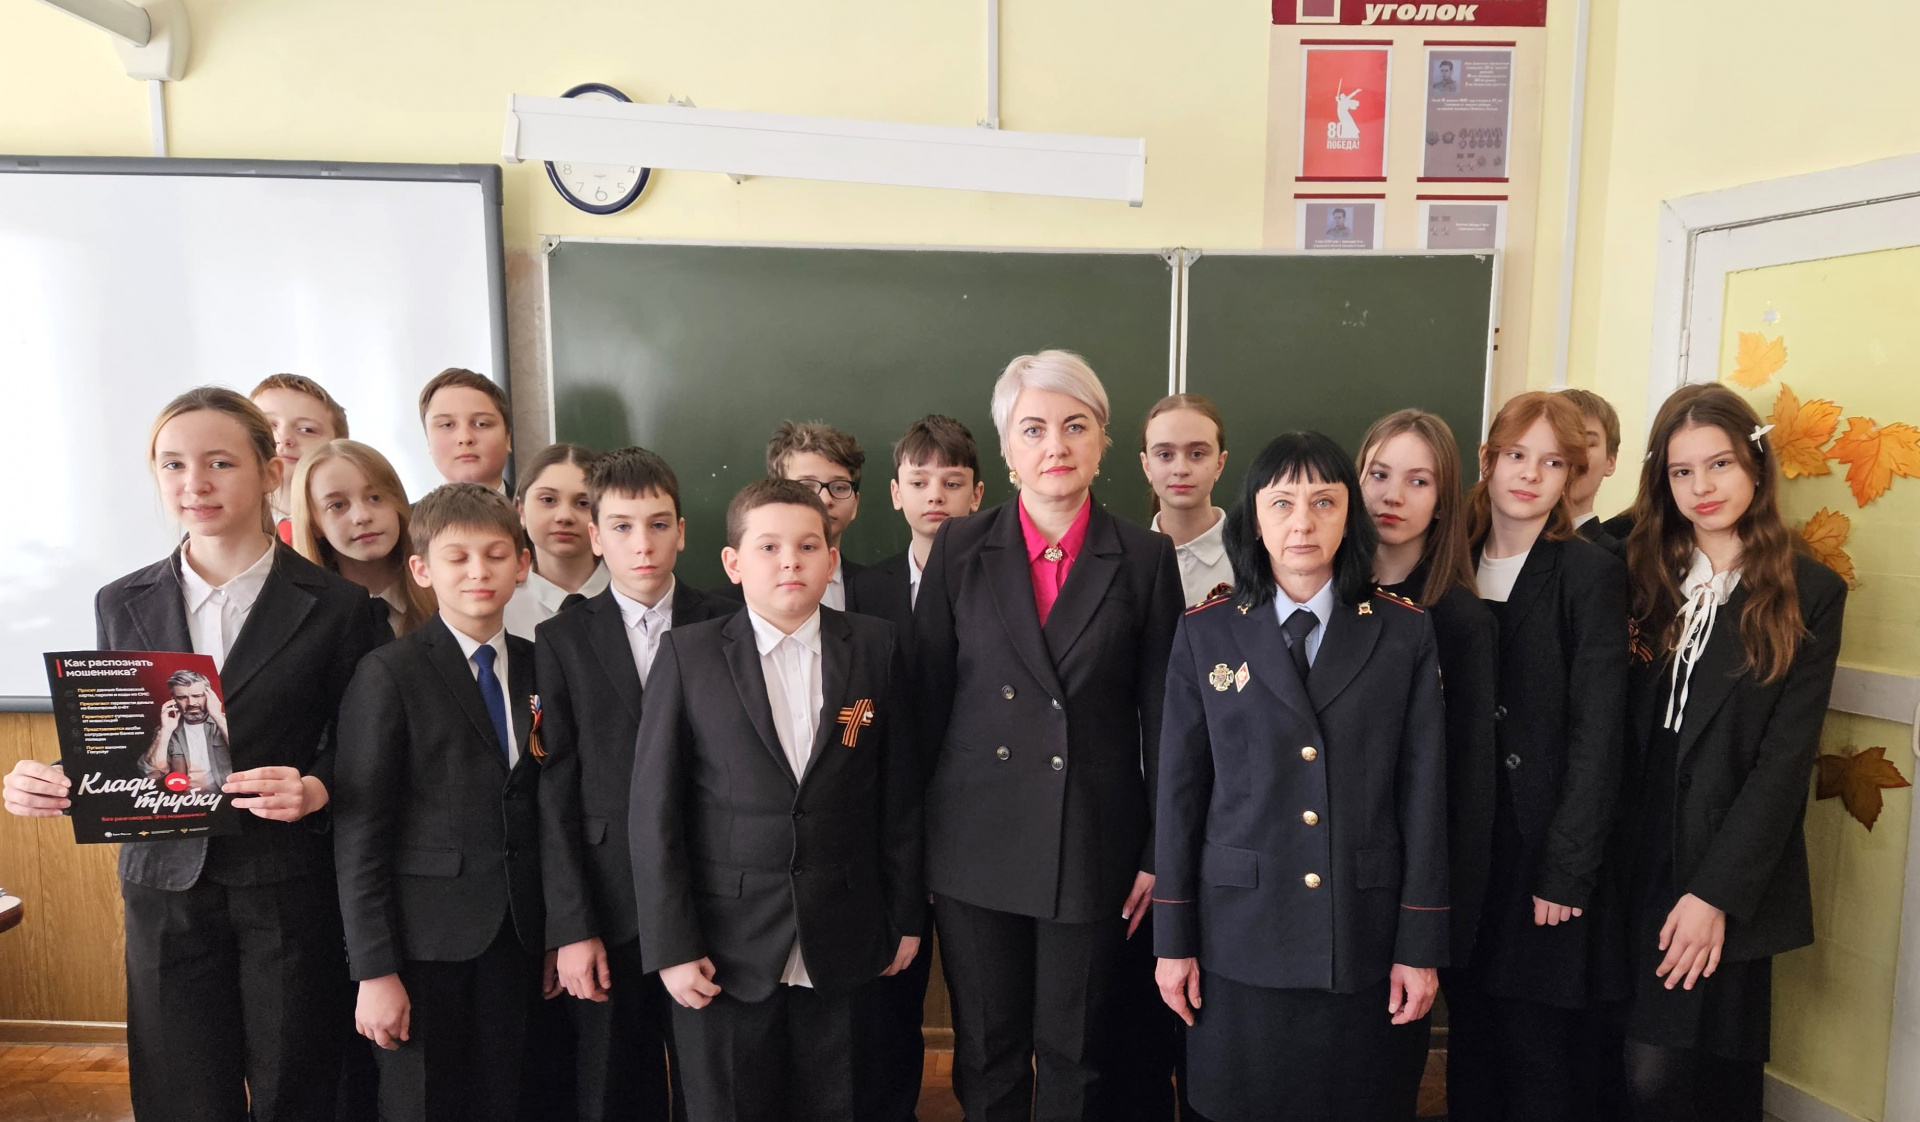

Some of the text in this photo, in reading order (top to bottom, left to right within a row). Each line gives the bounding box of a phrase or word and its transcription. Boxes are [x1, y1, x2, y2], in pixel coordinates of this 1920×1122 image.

[1361, 3, 1479, 25] уголок
[1327, 121, 1344, 138] 80
[1326, 140, 1360, 150] ПОБЕДА!
[563, 163, 573, 175] 8
[627, 166, 636, 175] 4
[576, 181, 584, 193] 7
[617, 182, 626, 193] 5
[594, 186, 608, 202] 6
[64, 659, 153, 669] Как распознать
[65, 668, 138, 677] мошенника?
[77, 771, 157, 798] Клади
[134, 787, 223, 814] трубку
